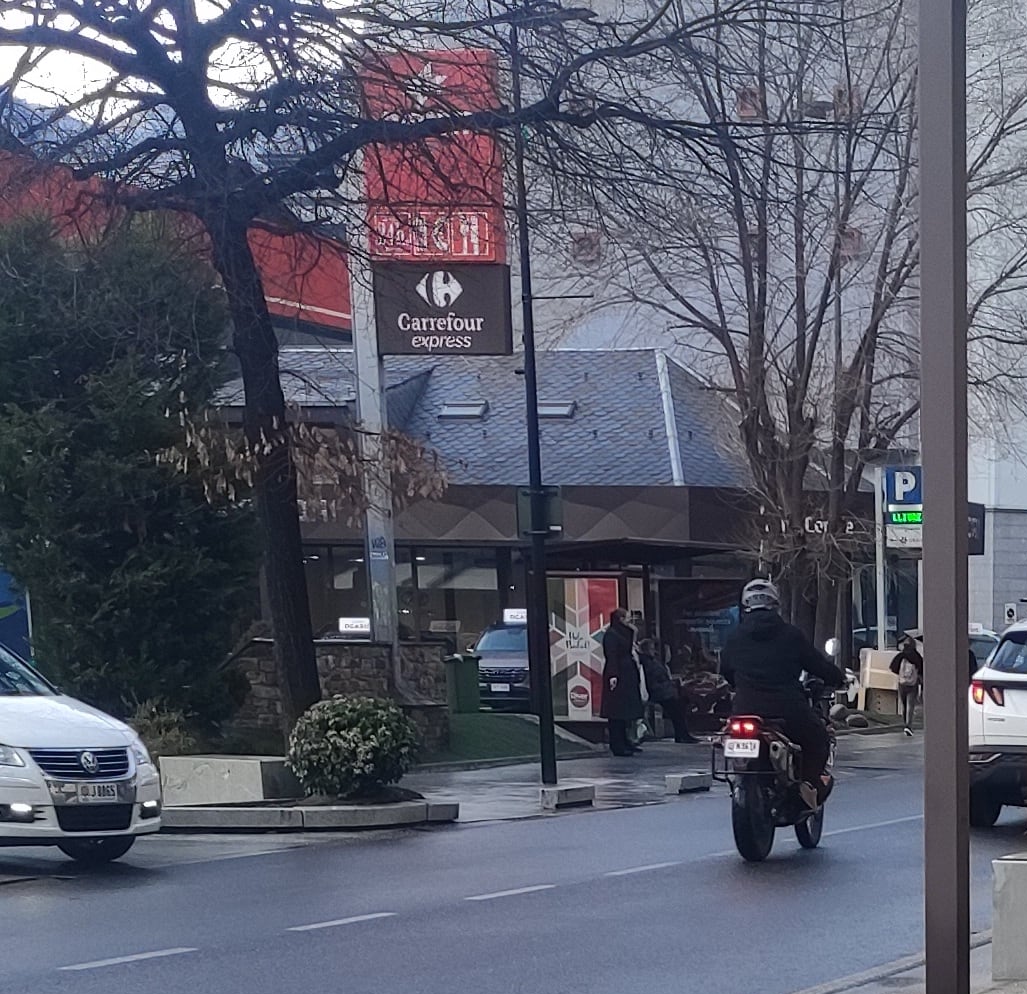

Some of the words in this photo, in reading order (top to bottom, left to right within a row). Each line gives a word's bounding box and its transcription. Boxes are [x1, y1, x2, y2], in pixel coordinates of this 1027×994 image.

[398, 312, 485, 331] Carrefour
[411, 335, 472, 352] express
[894, 471, 916, 501] P
